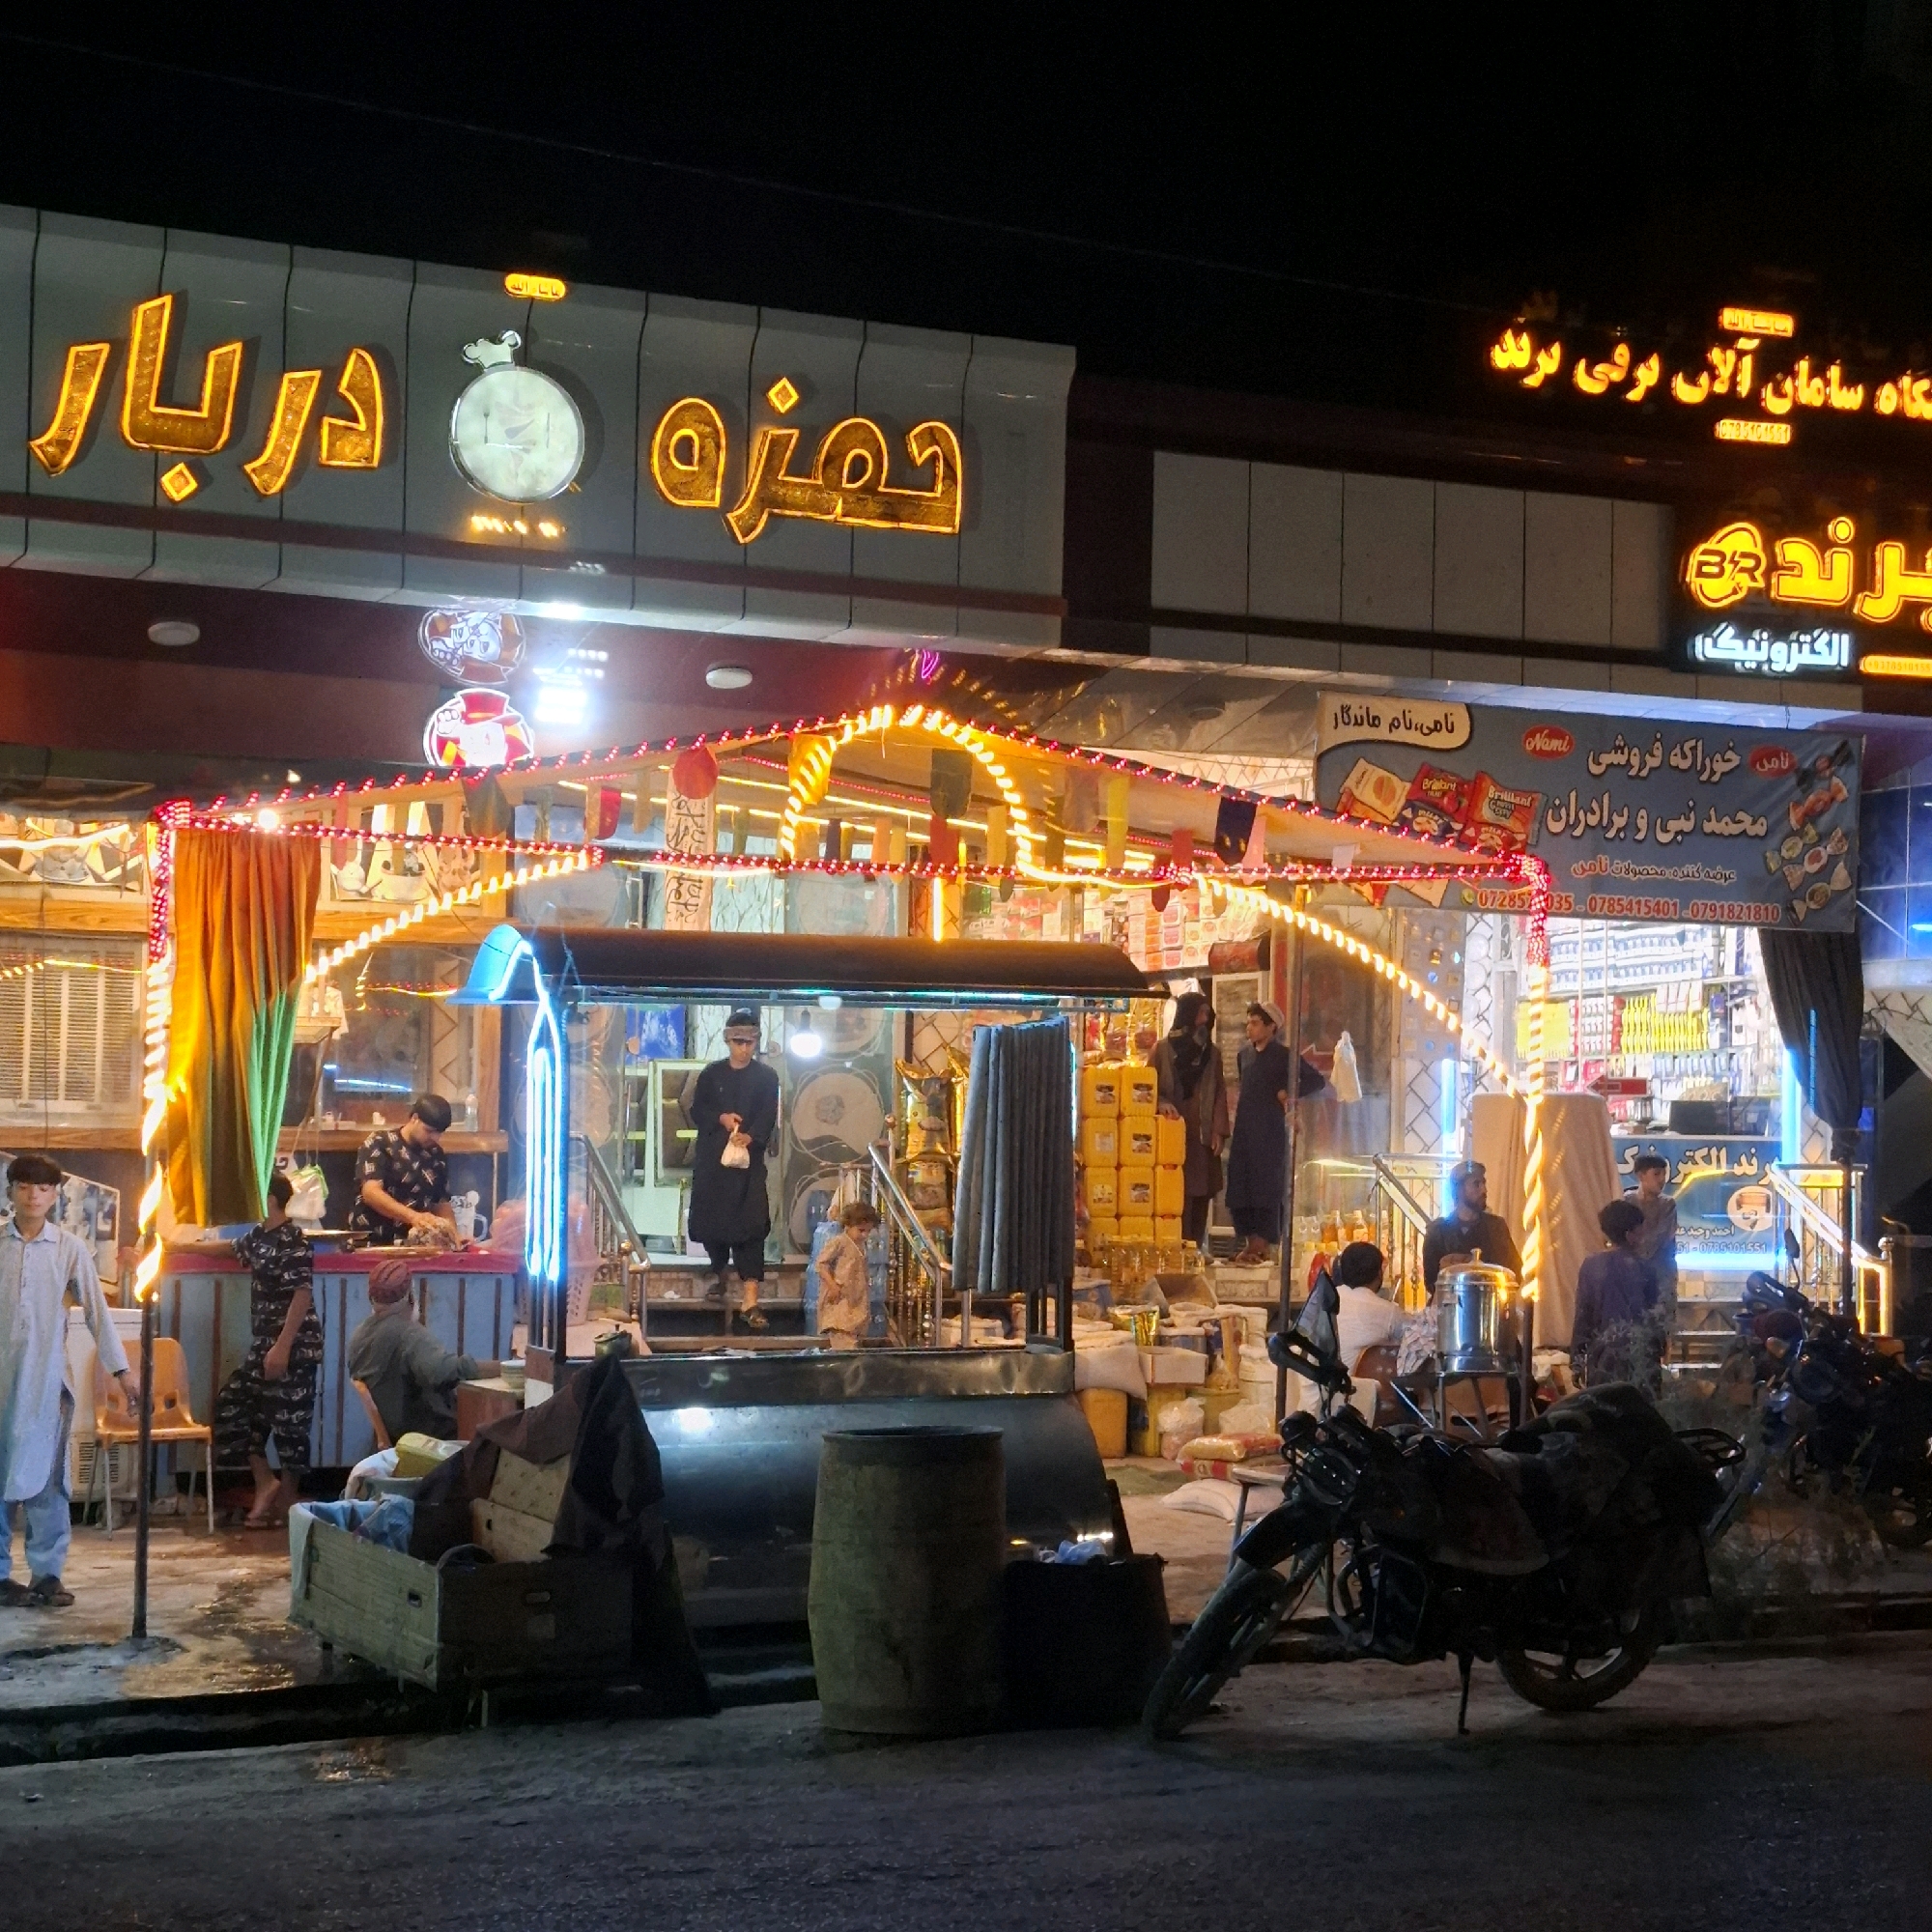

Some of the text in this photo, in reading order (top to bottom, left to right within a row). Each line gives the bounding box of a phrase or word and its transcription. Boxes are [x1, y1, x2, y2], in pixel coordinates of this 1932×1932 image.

[1761, 355, 1863, 414] سامان
[29, 294, 963, 545] حمزه دربار
[1696, 623, 1849, 672] الکترونیک
[1526, 729, 1571, 753] Nami
[1586, 731, 1742, 783] خوراکه فروشی
[1755, 752, 1790, 773] نامی
[1546, 787, 1630, 839] برادران
[1633, 808, 1648, 841] و
[1655, 798, 1696, 844] نبی
[1701, 806, 1770, 839] محمد
[1571, 854, 1610, 878] نامی
[1611, 860, 1667, 880] محصولات
[1703, 866, 1737, 886] عرضه
[1477, 889, 1575, 913] 07285035
[1587, 895, 1679, 918] 0785415401
[1734, 1147, 1780, 1184] رند
[1698, 1241, 1768, 1254] 0785101551
